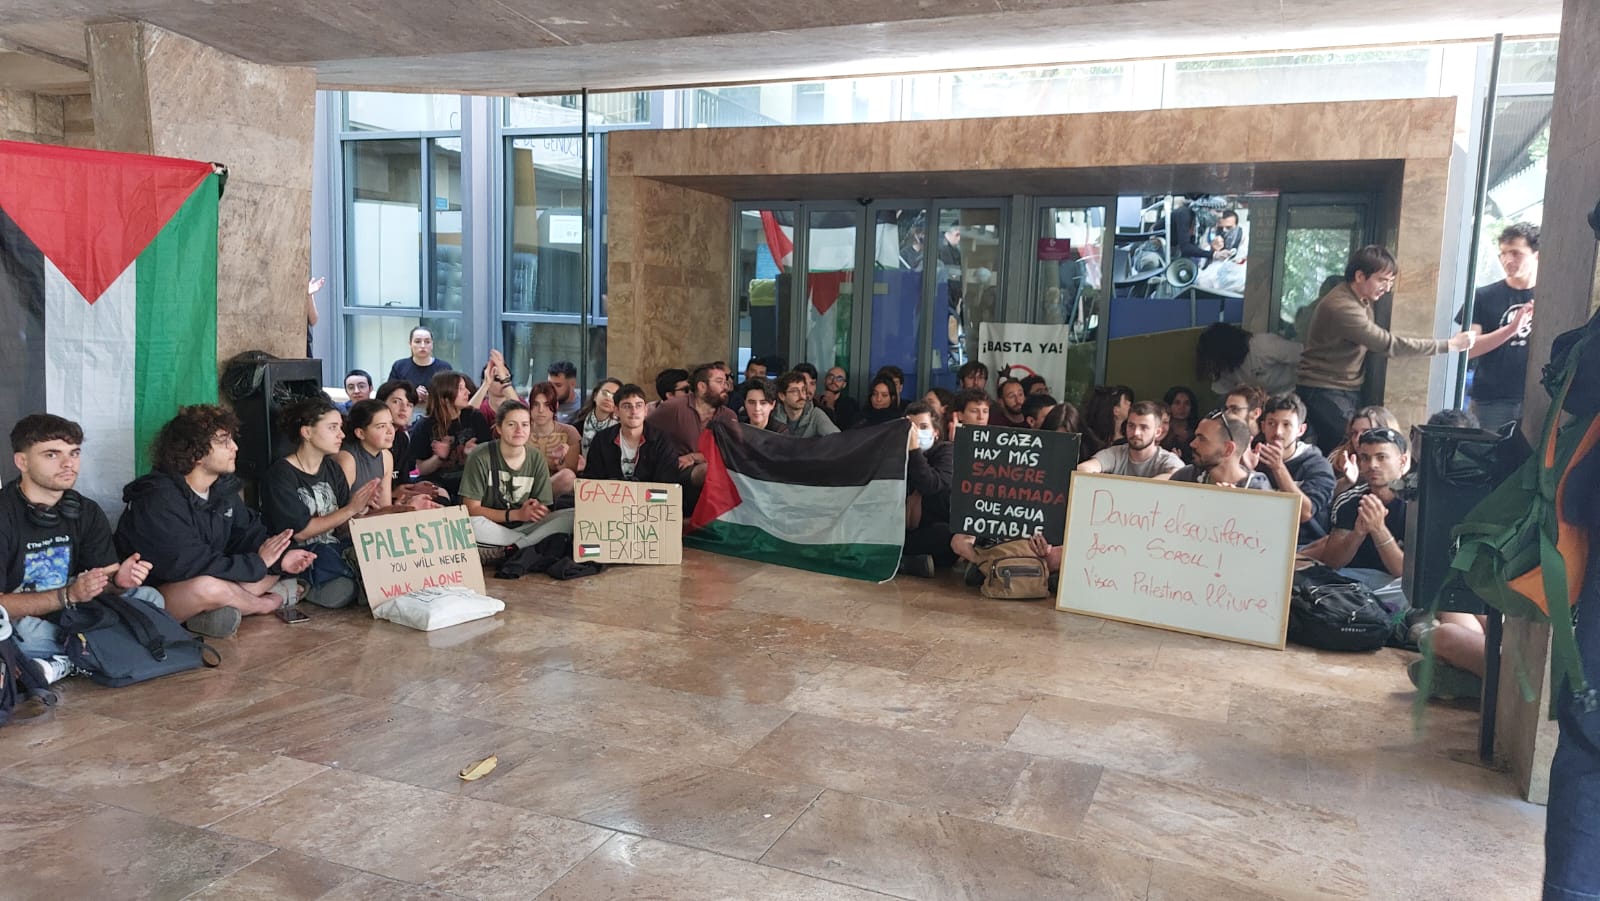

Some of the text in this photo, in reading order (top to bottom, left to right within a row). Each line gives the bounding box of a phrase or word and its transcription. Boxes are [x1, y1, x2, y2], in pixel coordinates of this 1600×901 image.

[983, 341, 1063, 354] ¡BASTA YA!
[973, 431, 1042, 448] EN GAZA
[974, 448, 1001, 460] HAY
[972, 462, 1046, 484] SANGRE
[580, 481, 636, 504] GAZA
[961, 480, 1065, 505] DERRAMADA
[622, 504, 678, 525] RESISTE
[975, 500, 1044, 522] QUE AGUA
[1089, 489, 1160, 532] Davant
[578, 520, 658, 541] PALESTINA
[609, 541, 660, 560] EXISTE
[390, 561, 408, 573] YOU
[439, 552, 468, 565] NEVER
[380, 582, 413, 599] WALK
[422, 571, 463, 589] ALONE
[1084, 567, 1118, 590] Visca
